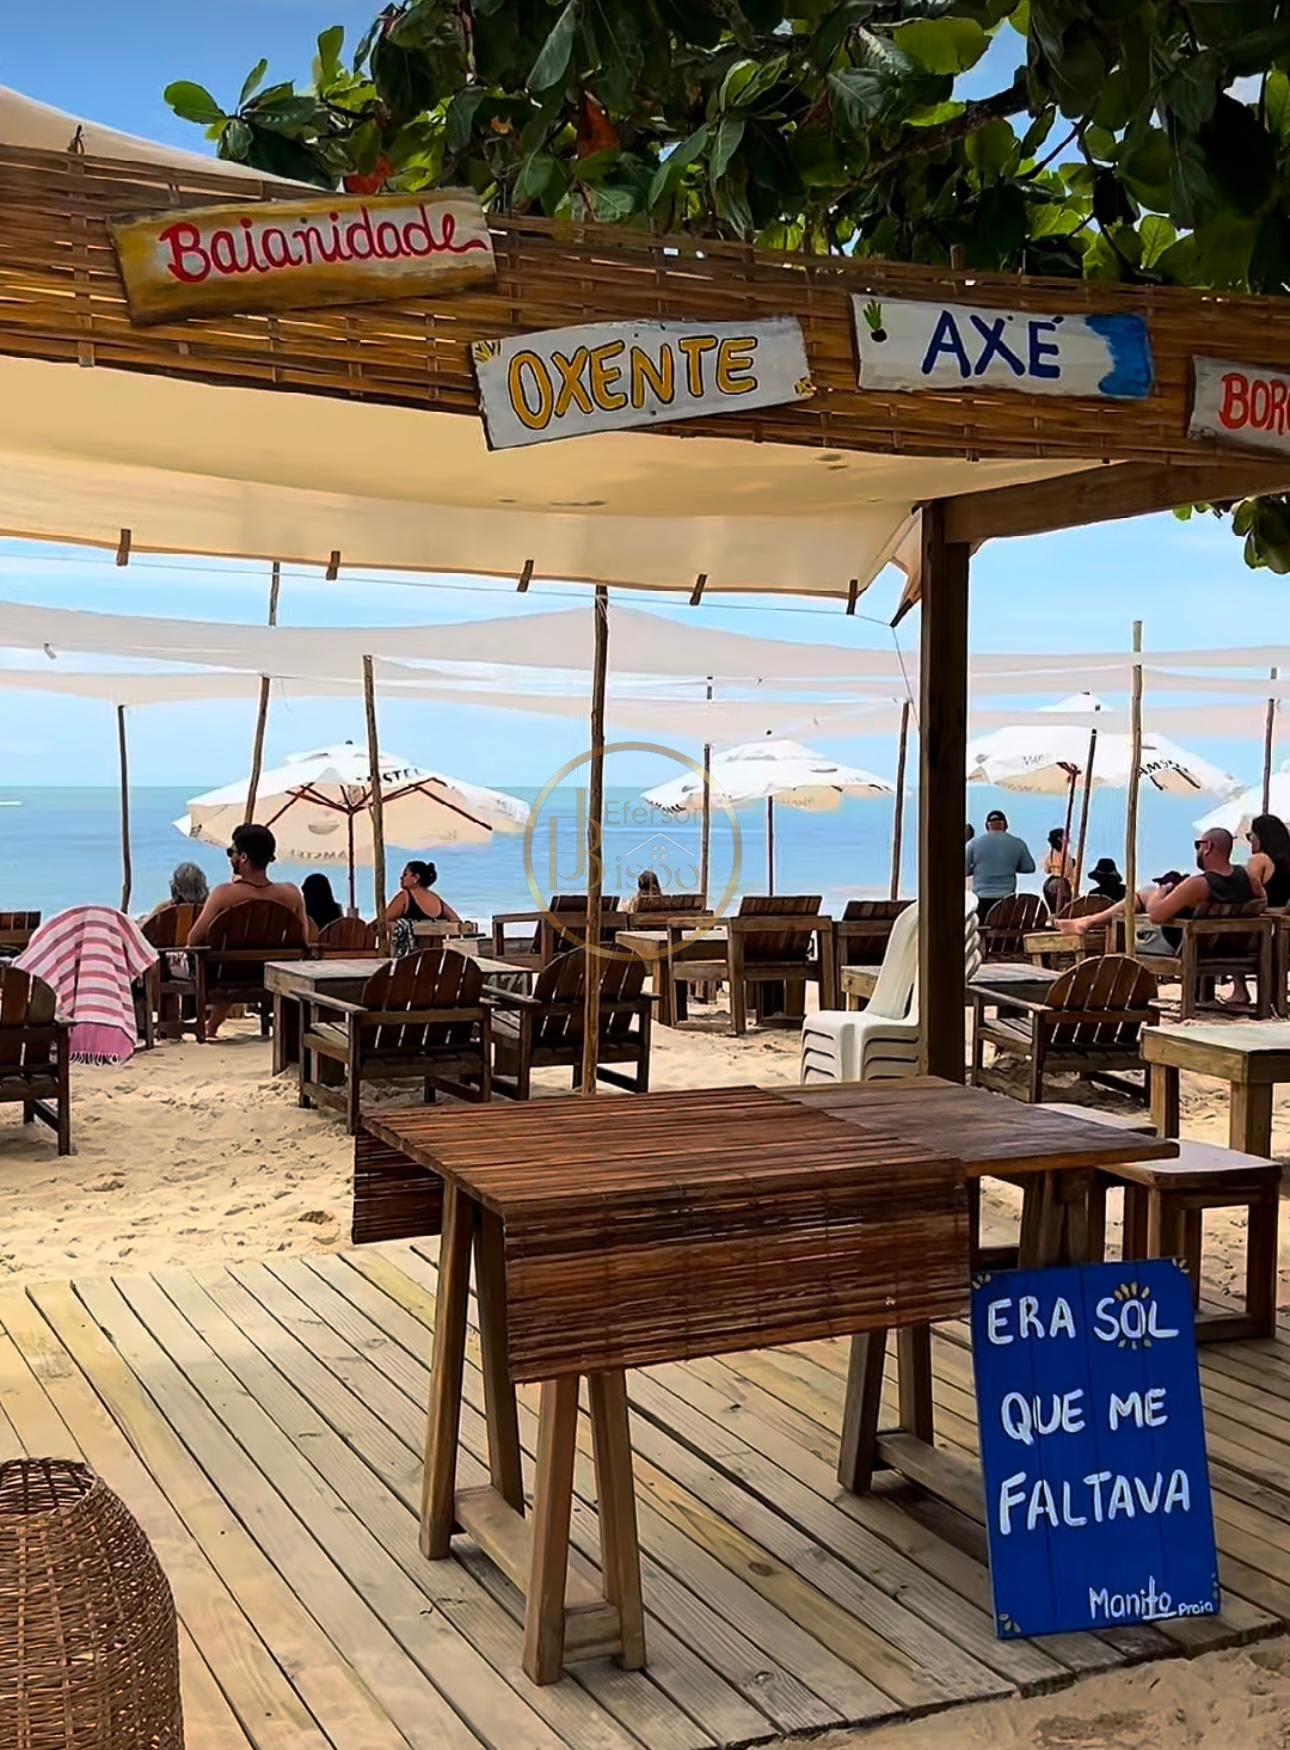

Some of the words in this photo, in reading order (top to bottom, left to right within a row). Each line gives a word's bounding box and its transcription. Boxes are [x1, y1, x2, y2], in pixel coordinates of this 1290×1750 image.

[159, 203, 488, 284] Baianidade
[508, 335, 758, 431] OXENTE
[1218, 372, 1290, 436] BOR
[987, 1296, 1076, 1345] ERA
[1094, 1297, 1180, 1342] SOL
[1001, 1389, 1086, 1446] QUE
[1108, 1388, 1168, 1432] ME
[999, 1469, 1191, 1536] FALTAVA
[1089, 1575, 1175, 1620] Manito
